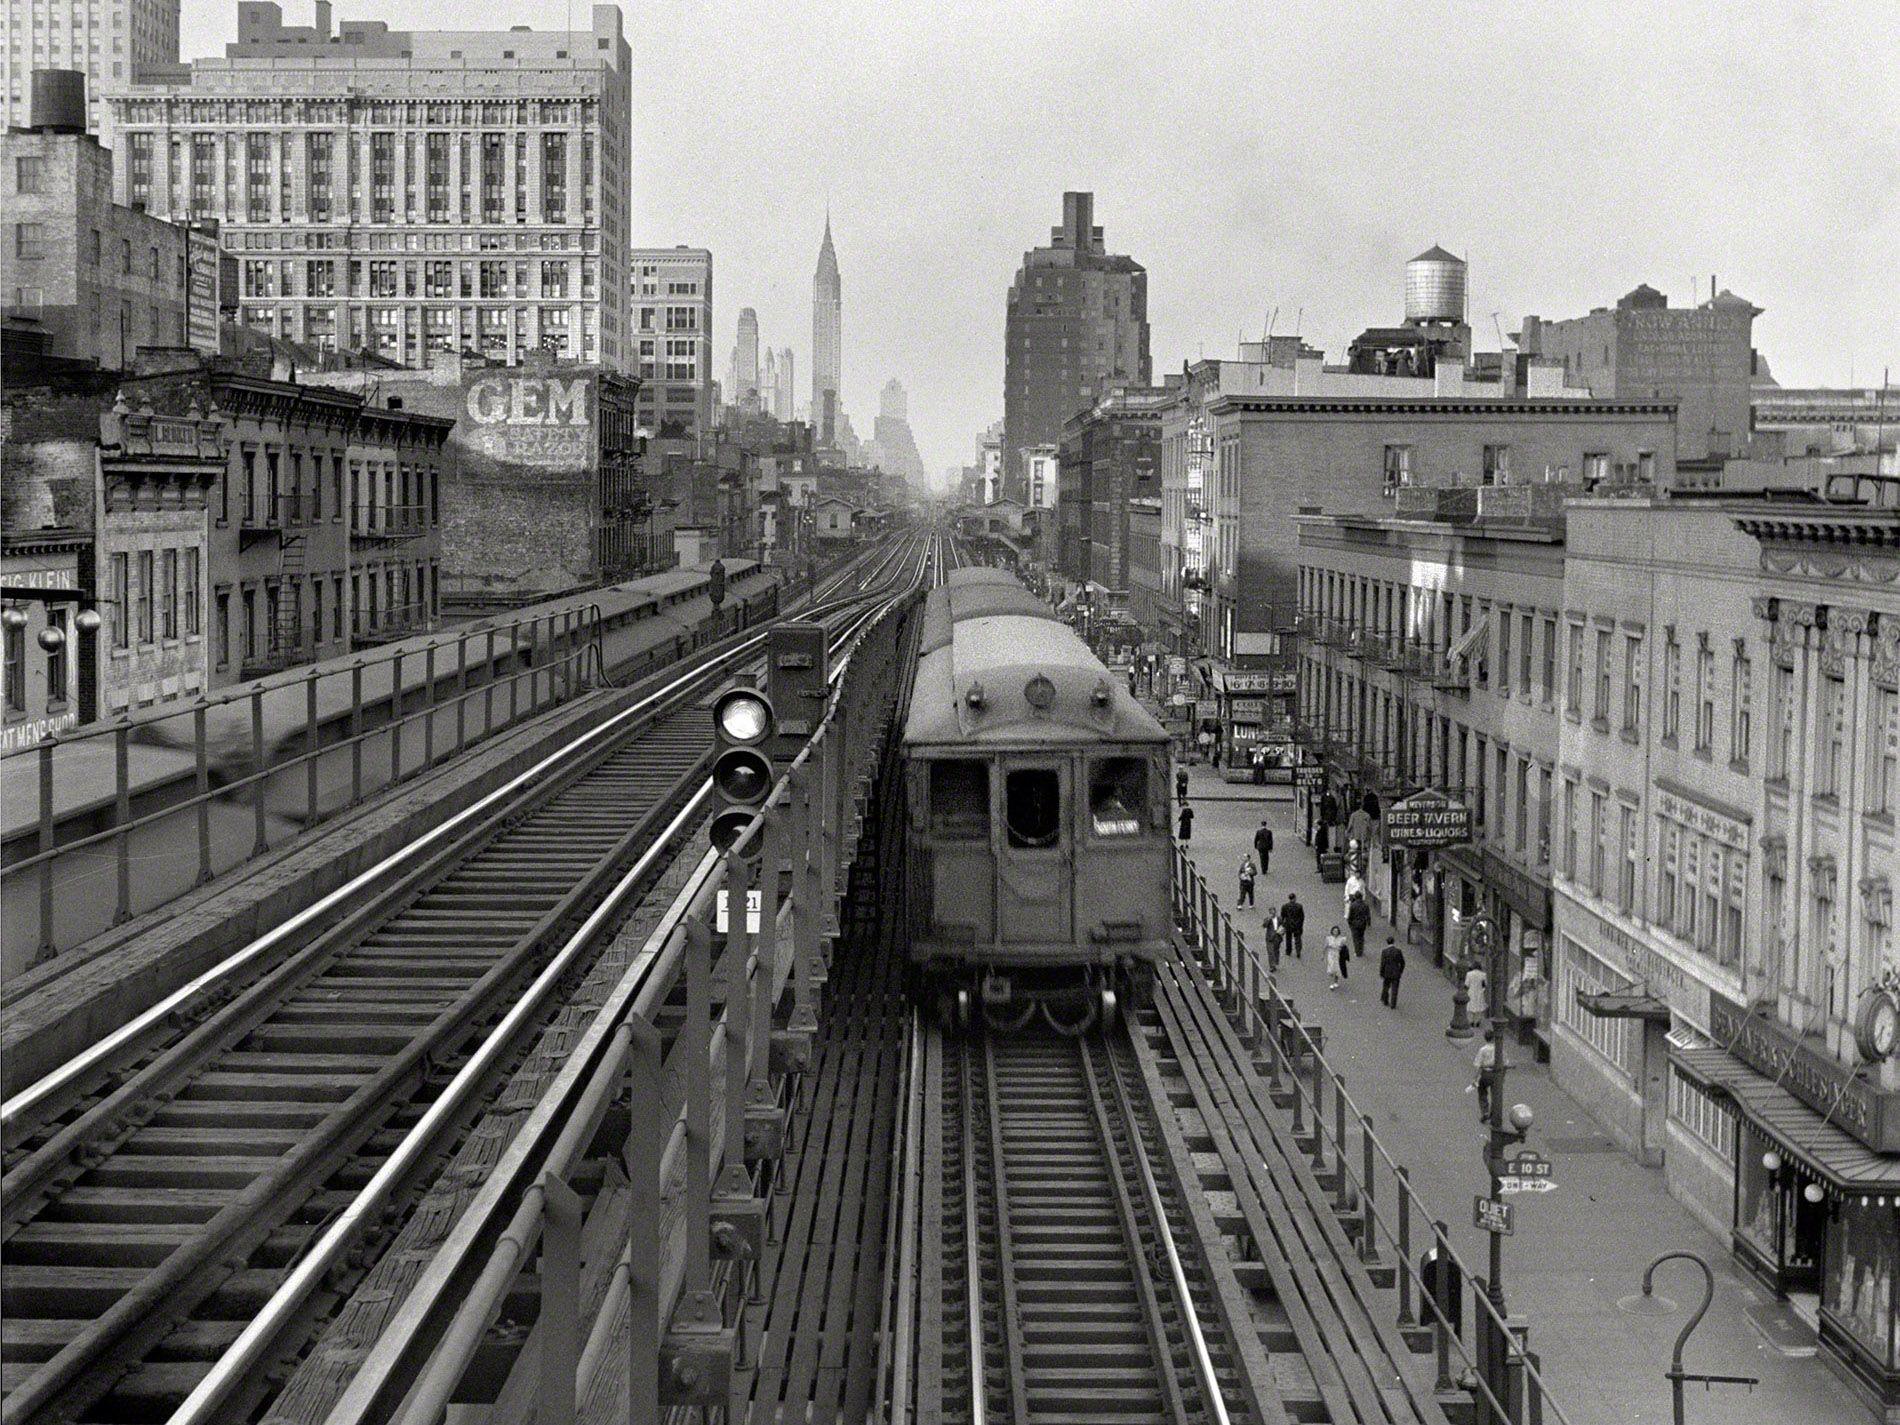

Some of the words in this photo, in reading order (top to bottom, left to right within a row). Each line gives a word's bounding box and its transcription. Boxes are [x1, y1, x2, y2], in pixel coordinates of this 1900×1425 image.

[466, 377, 590, 424] GEM
[1, 728, 15, 749] AT
[1387, 813, 1419, 824] BEER
[1424, 812, 1467, 824] TAVERN
[1508, 1163, 1516, 1174] E
[1521, 1163, 1532, 1174] 10
[1536, 1163, 1549, 1174] ST
